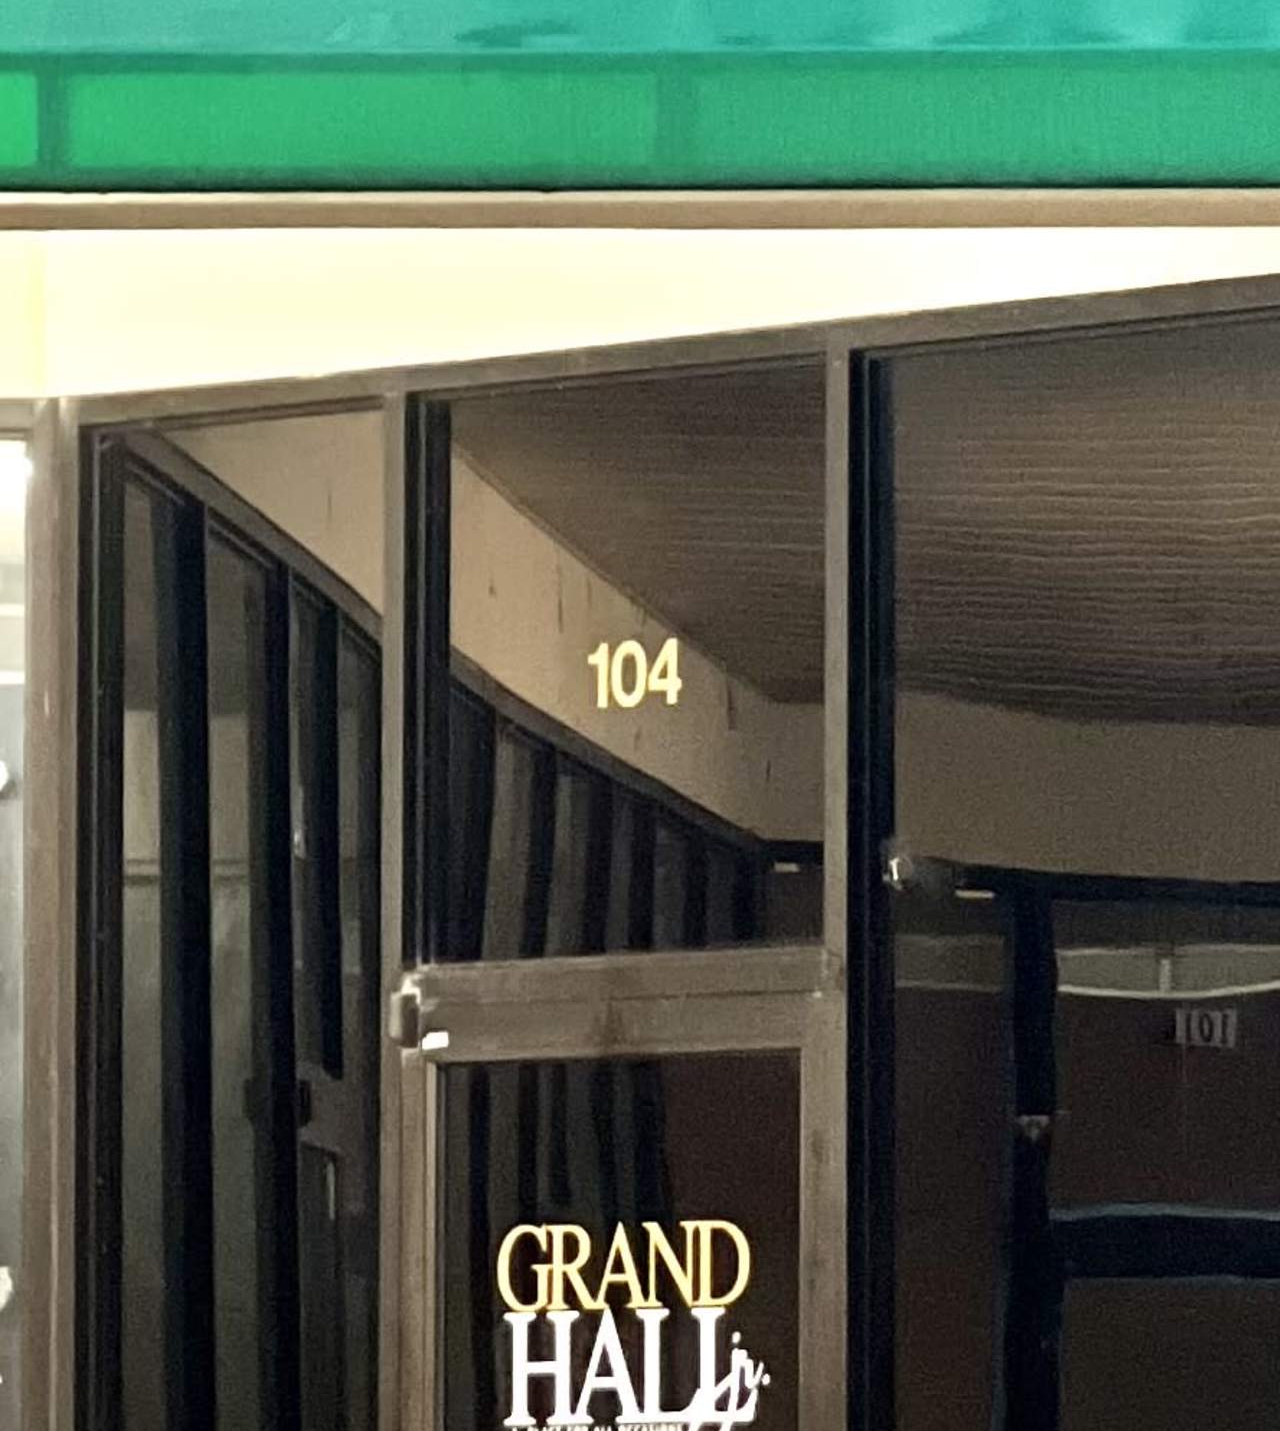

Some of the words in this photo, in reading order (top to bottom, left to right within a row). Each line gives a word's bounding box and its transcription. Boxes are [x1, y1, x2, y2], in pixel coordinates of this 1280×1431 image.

[587, 638, 683, 709] 104
[496, 1219, 751, 1313] GRAND
[503, 1307, 757, 1427] HALL
